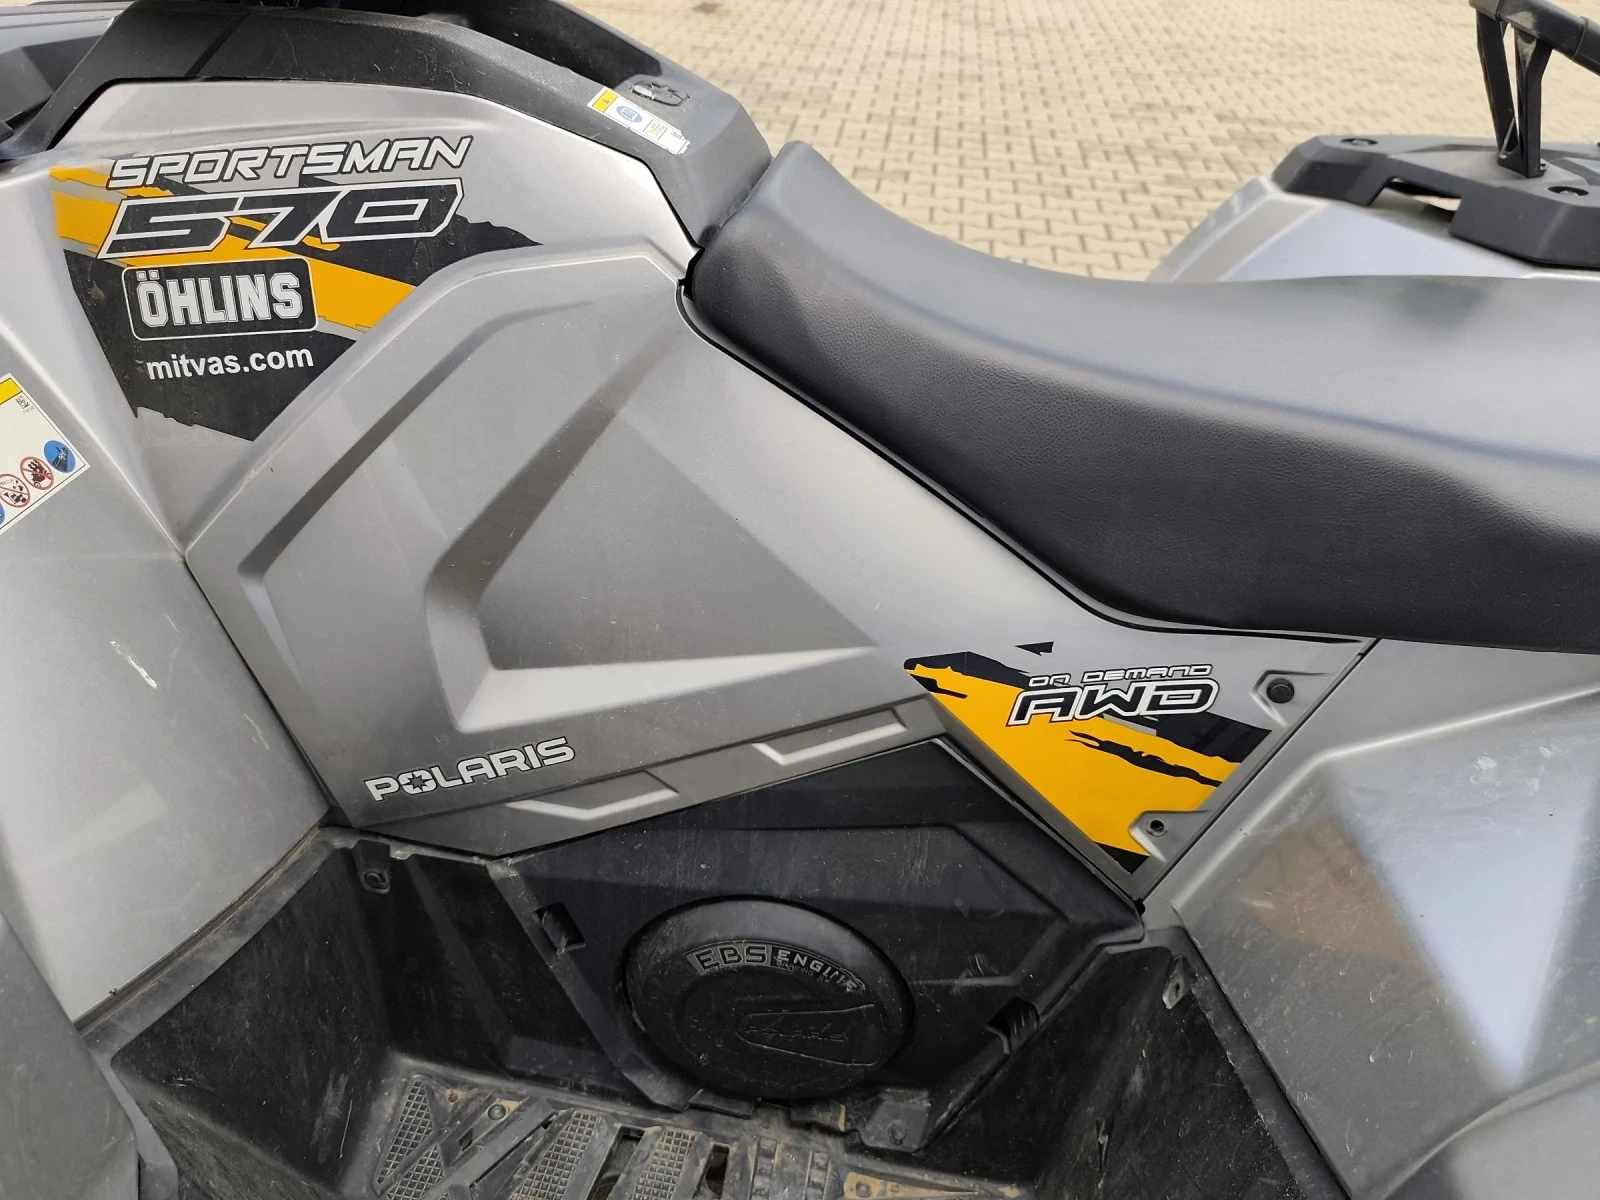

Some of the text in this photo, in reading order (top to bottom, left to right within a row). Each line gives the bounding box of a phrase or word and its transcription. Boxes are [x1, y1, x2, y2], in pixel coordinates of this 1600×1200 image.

[106, 135, 474, 189] SPORTSMAN
[97, 178, 464, 259] 570
[136, 269, 304, 328] ÖHLINS
[147, 346, 314, 380] mitvas.com
[1028, 664, 1213, 687] ON DEMAND
[1006, 679, 1220, 727] AWD
[364, 736, 575, 801] POLARIS
[693, 944, 768, 972] EBS
